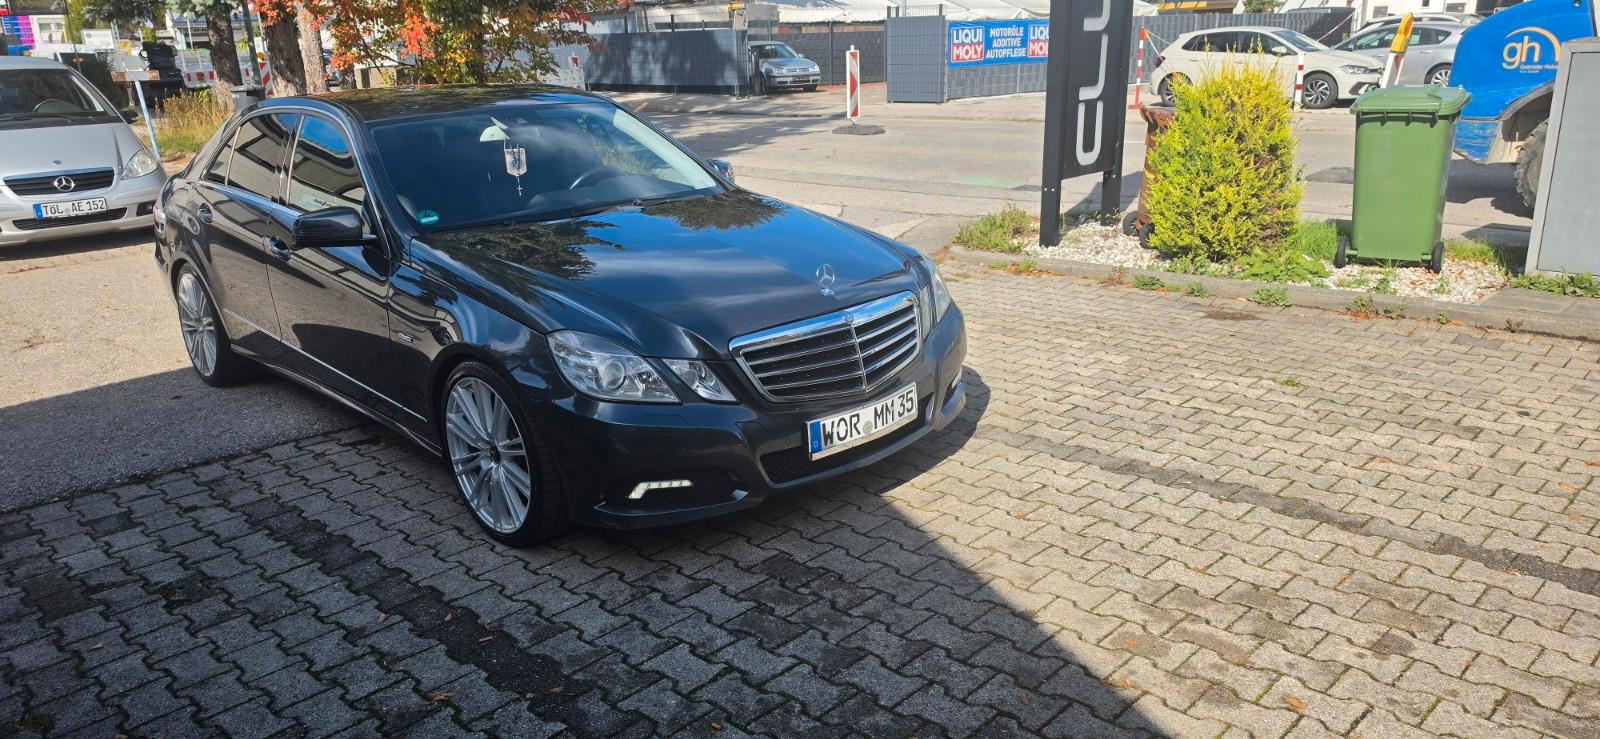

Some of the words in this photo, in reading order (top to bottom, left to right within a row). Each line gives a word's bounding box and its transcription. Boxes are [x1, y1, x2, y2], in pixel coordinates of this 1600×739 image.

[953, 28, 983, 44] LIQUI
[990, 25, 1024, 38] MOTORÖLE
[992, 37, 1021, 47] ADDITIVE
[953, 44, 983, 60] MOLY
[985, 47, 1026, 58] AUTOPFLEGE
[1502, 35, 1540, 70] gh
[43, 204, 63, 215] TÖL
[71, 202, 84, 213] AE
[86, 199, 105, 211] 152
[822, 413, 861, 447] WOR
[873, 399, 895, 429] MM
[897, 389, 914, 418] 35
